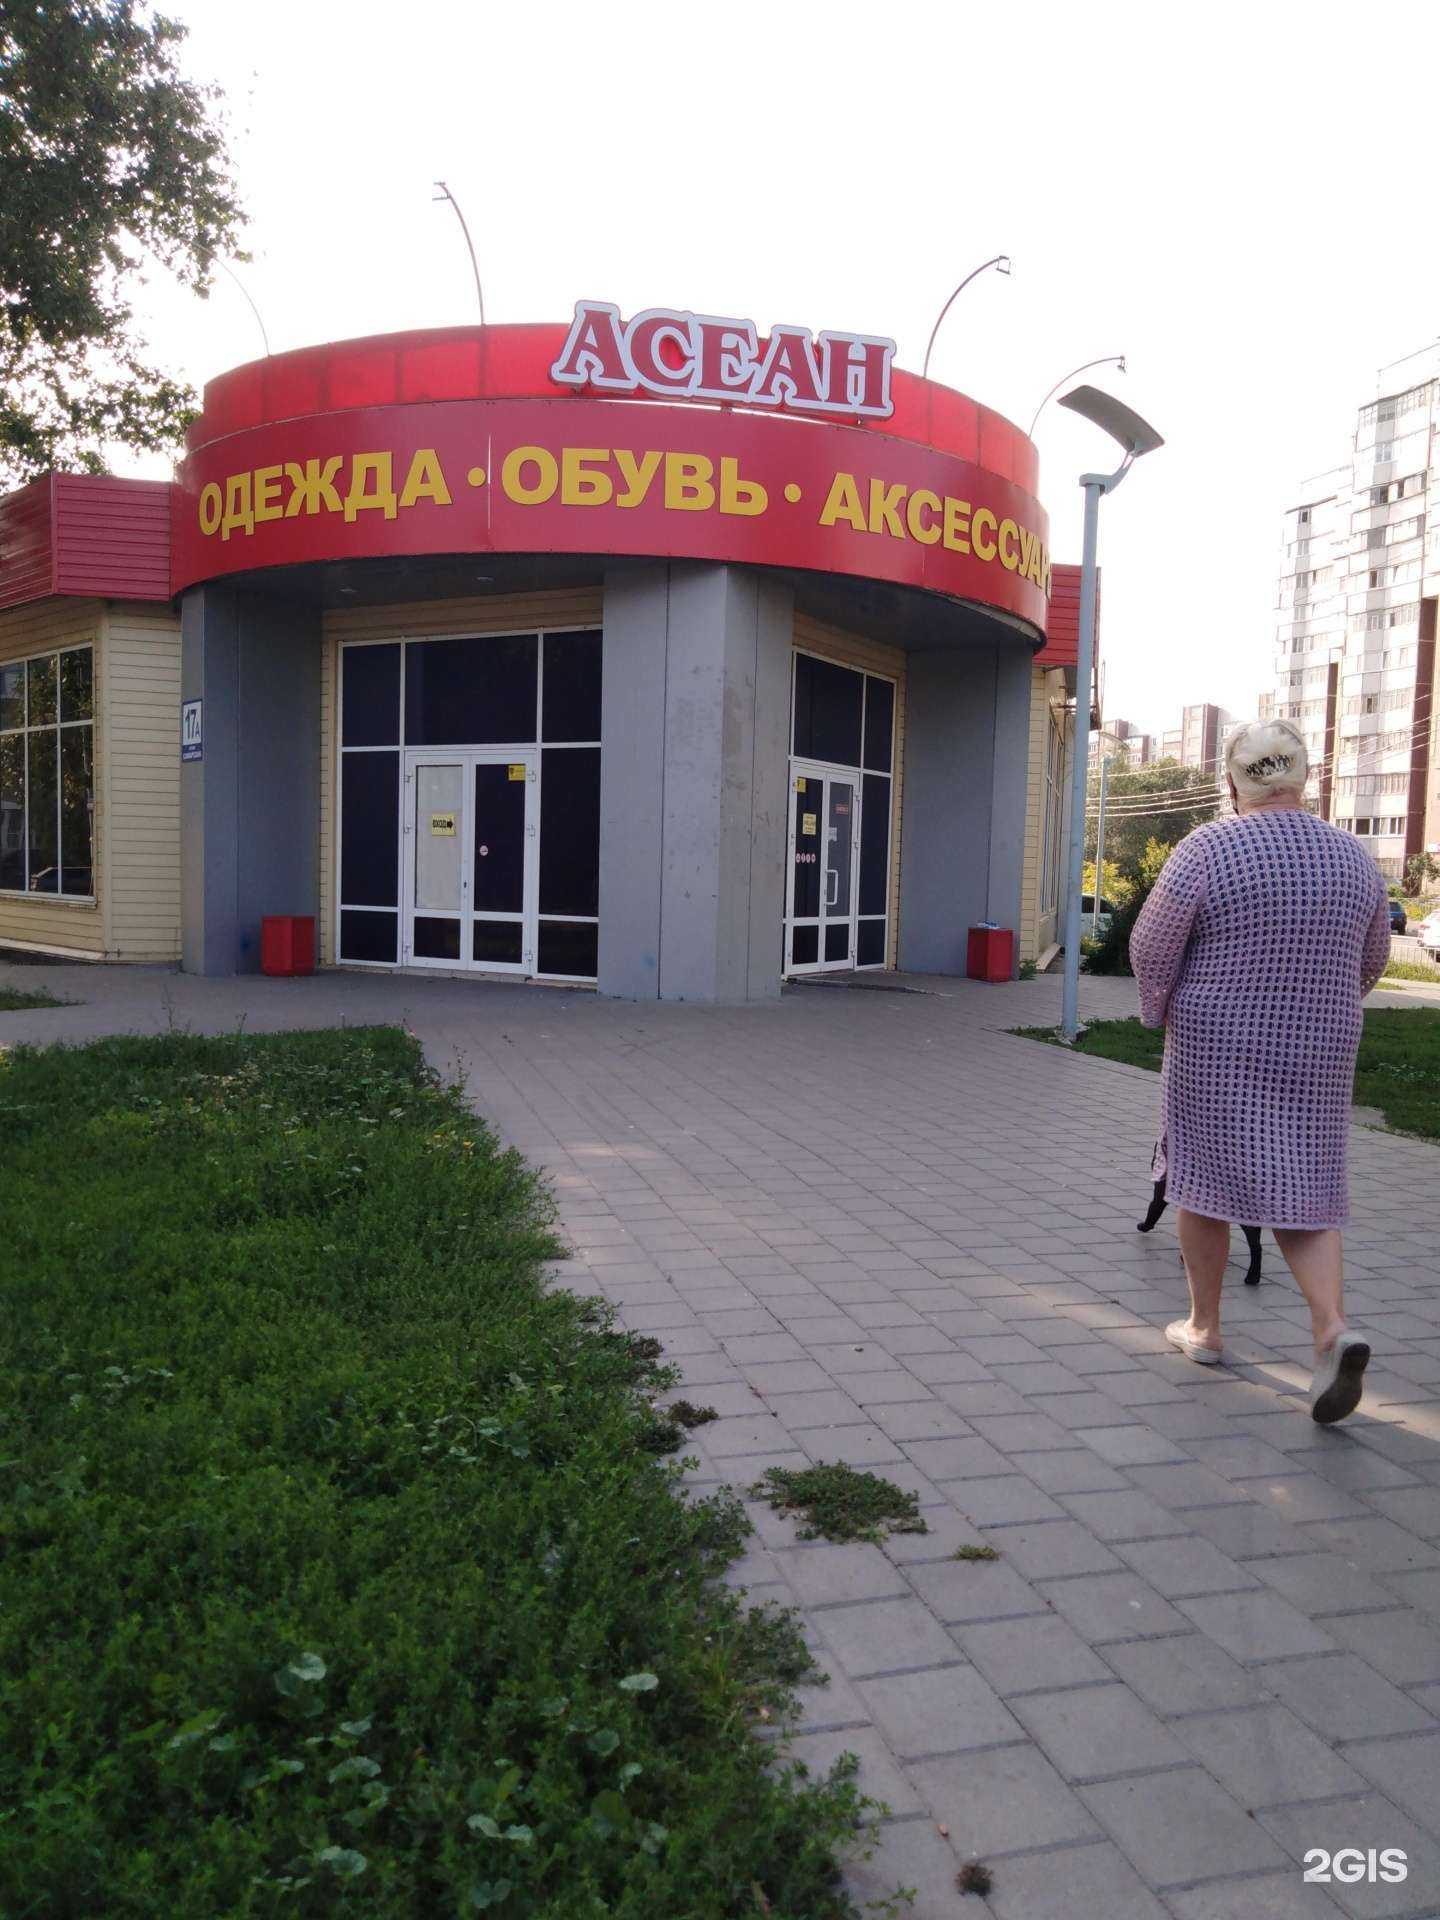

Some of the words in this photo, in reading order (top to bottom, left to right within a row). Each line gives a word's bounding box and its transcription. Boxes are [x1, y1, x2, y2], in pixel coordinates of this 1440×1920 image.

[551, 301, 896, 416] АСЕАН
[199, 448, 452, 540] ОДЕЖДА
[501, 446, 769, 516] ОБУВЬ
[819, 472, 1051, 600] АКСЕССУАР
